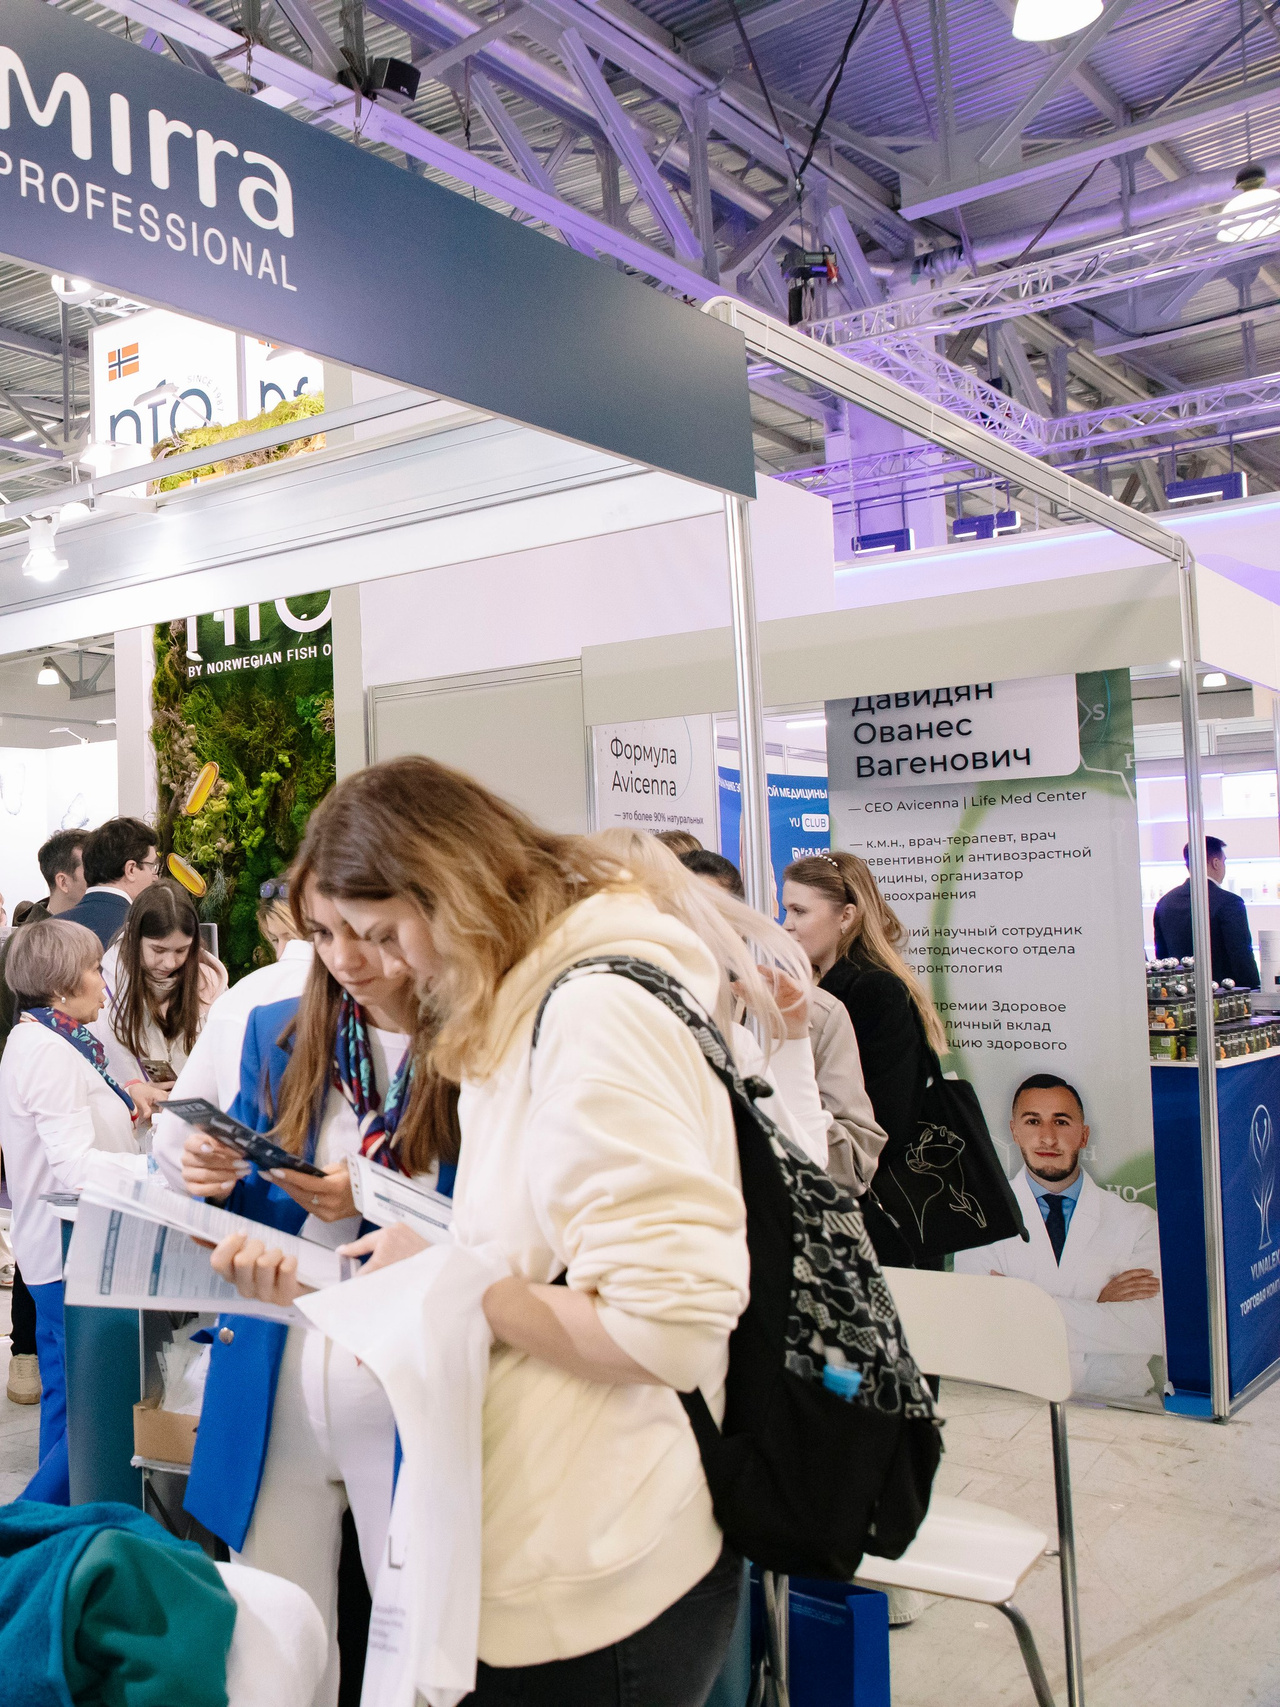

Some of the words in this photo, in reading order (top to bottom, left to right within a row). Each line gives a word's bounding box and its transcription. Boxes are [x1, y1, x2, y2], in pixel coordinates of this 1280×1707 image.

[186, 374, 213, 387] SINCE
[188, 664, 203, 678] BY
[206, 651, 282, 675] NORWEGIAN
[287, 646, 318, 662] FISH
[853, 717, 973, 744] Ованес
[610, 736, 677, 767] Формула
[856, 748, 1031, 778] Вагенович
[612, 770, 677, 796] Avicenna
[780, 787, 828, 800] МЕДИЦИНЫ
[864, 802, 893, 813] CEO
[896, 799, 959, 812] Avicenna
[971, 795, 997, 807] Life
[1001, 793, 1032, 806] Med
[1036, 790, 1087, 803] Center
[622, 812, 632, 820] это
[634, 810, 652, 821] более
[654, 812, 666, 822] 90%
[667, 815, 704, 825] натуральных
[789, 817, 800, 827] YU
[805, 818, 826, 828] CLUB
[866, 838, 905, 849] к.м.н.,
[909, 832, 1017, 848] врач-терапевт,
[1021, 831, 1056, 844] врач
[955, 855, 964, 863] и
[968, 847, 1092, 862] антивозрастной
[931, 869, 1023, 883] организатор
[934, 925, 997, 939] научный
[1001, 925, 1083, 938] сотрудник
[1023, 944, 1075, 955] отдела
[992, 1001, 1066, 1014] Здоровое
[944, 1019, 1001, 1030] личный
[1007, 1021, 1051, 1032] вклад
[987, 1039, 1067, 1051] здорового
